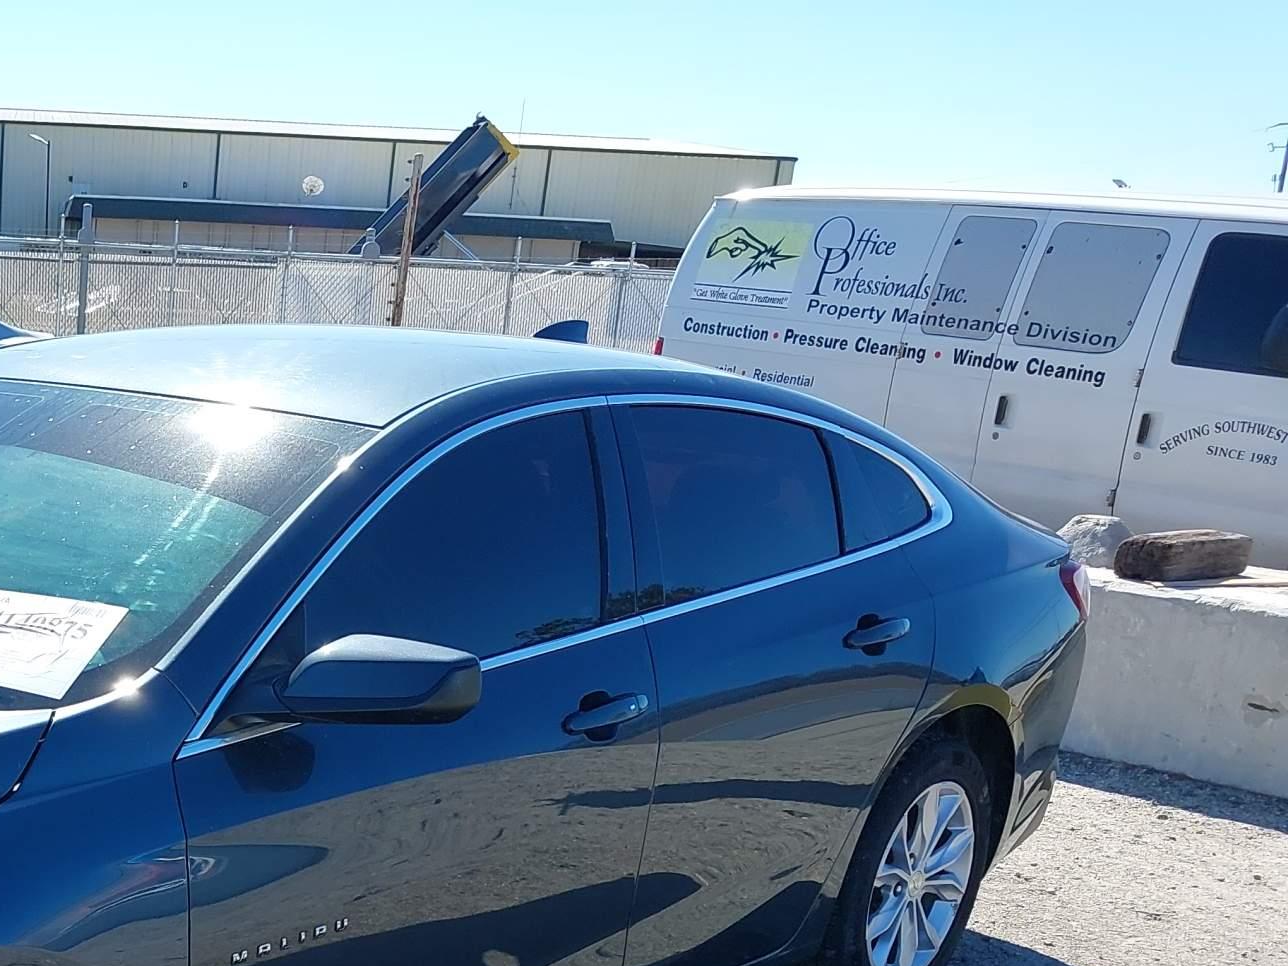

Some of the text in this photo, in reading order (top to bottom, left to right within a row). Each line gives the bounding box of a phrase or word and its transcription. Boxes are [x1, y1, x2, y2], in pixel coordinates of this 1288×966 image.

[814, 215, 897, 261] Office
[806, 246, 968, 303] Professionals Inc.
[807, 299, 1117, 348] Property Maintenance Division
[683, 317, 1106, 387] Construction Pressure Cleaning Window Cleaning
[752, 368, 814, 387] Residential
[1159, 424, 1210, 454] SERVING
[1206, 445, 1278, 466] SINCE 1983
[231, 918, 349, 965] MALIBU
